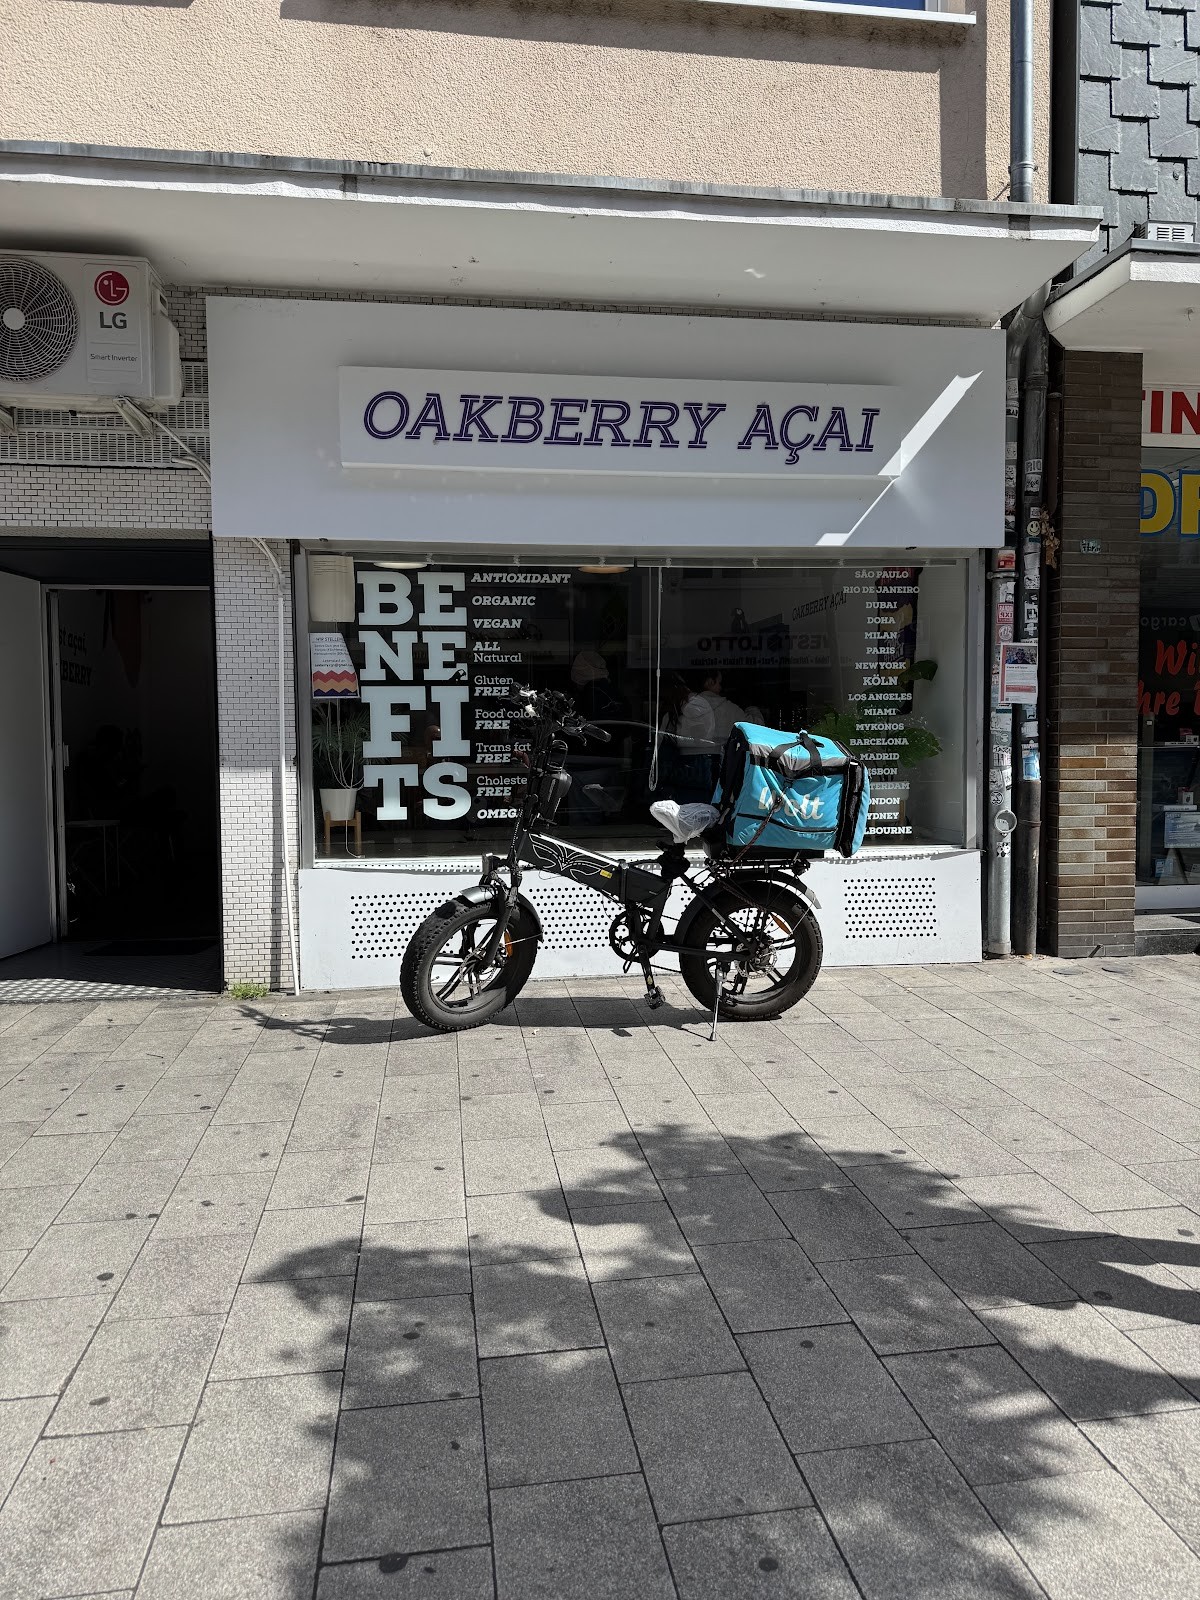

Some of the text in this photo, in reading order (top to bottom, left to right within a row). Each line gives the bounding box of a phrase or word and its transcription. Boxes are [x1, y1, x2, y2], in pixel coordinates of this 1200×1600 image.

[99, 311, 127, 329] LG
[90, 353, 137, 362] Smart Inverter
[1141, 390, 1200, 435] IN
[363, 390, 881, 465] OAKBERRY AÇAI
[471, 573, 572, 584] ANTIOXIDANT
[855, 569, 909, 579] SÃO PAULO
[843, 586, 921, 594] RIO DE JANEIRO
[357, 571, 468, 626] BE
[472, 595, 537, 607] ORGANIC
[865, 601, 898, 609] DUBAI
[473, 618, 523, 629] VEGAN
[864, 632, 898, 640] MILAN
[473, 641, 501, 652] ALL
[866, 646, 896, 654] PARIS
[359, 631, 469, 681] NE
[474, 652, 523, 663] Natural
[1154, 640, 1200, 676] Wi
[855, 662, 906, 670] NEW YORK
[474, 675, 515, 686] Gluten
[863, 674, 899, 686] KÖLN
[474, 686, 510, 697] FREE
[848, 692, 913, 701] LOS ANGELES
[1137, 679, 1181, 716] hre
[475, 708, 505, 719] Food
[864, 708, 897, 716] MIAMI
[360, 686, 471, 758] FI
[475, 720, 511, 730] FREE
[856, 722, 905, 731] MYKONOS
[476, 741, 532, 753] Trans fat
[849, 737, 909, 746] BARCELONA
[475, 753, 512, 764] FREE
[859, 752, 900, 761] MADRID
[868, 767, 898, 776] ISBON
[476, 775, 528, 786] Choleste
[363, 761, 472, 821] TS
[476, 786, 512, 797] FREE
[870, 782, 911, 791] TERDAM
[868, 797, 901, 806] ONDON
[477, 808, 523, 819] OMEG
[867, 812, 900, 820] YDNEY
[864, 826, 913, 835] LBOURNE
